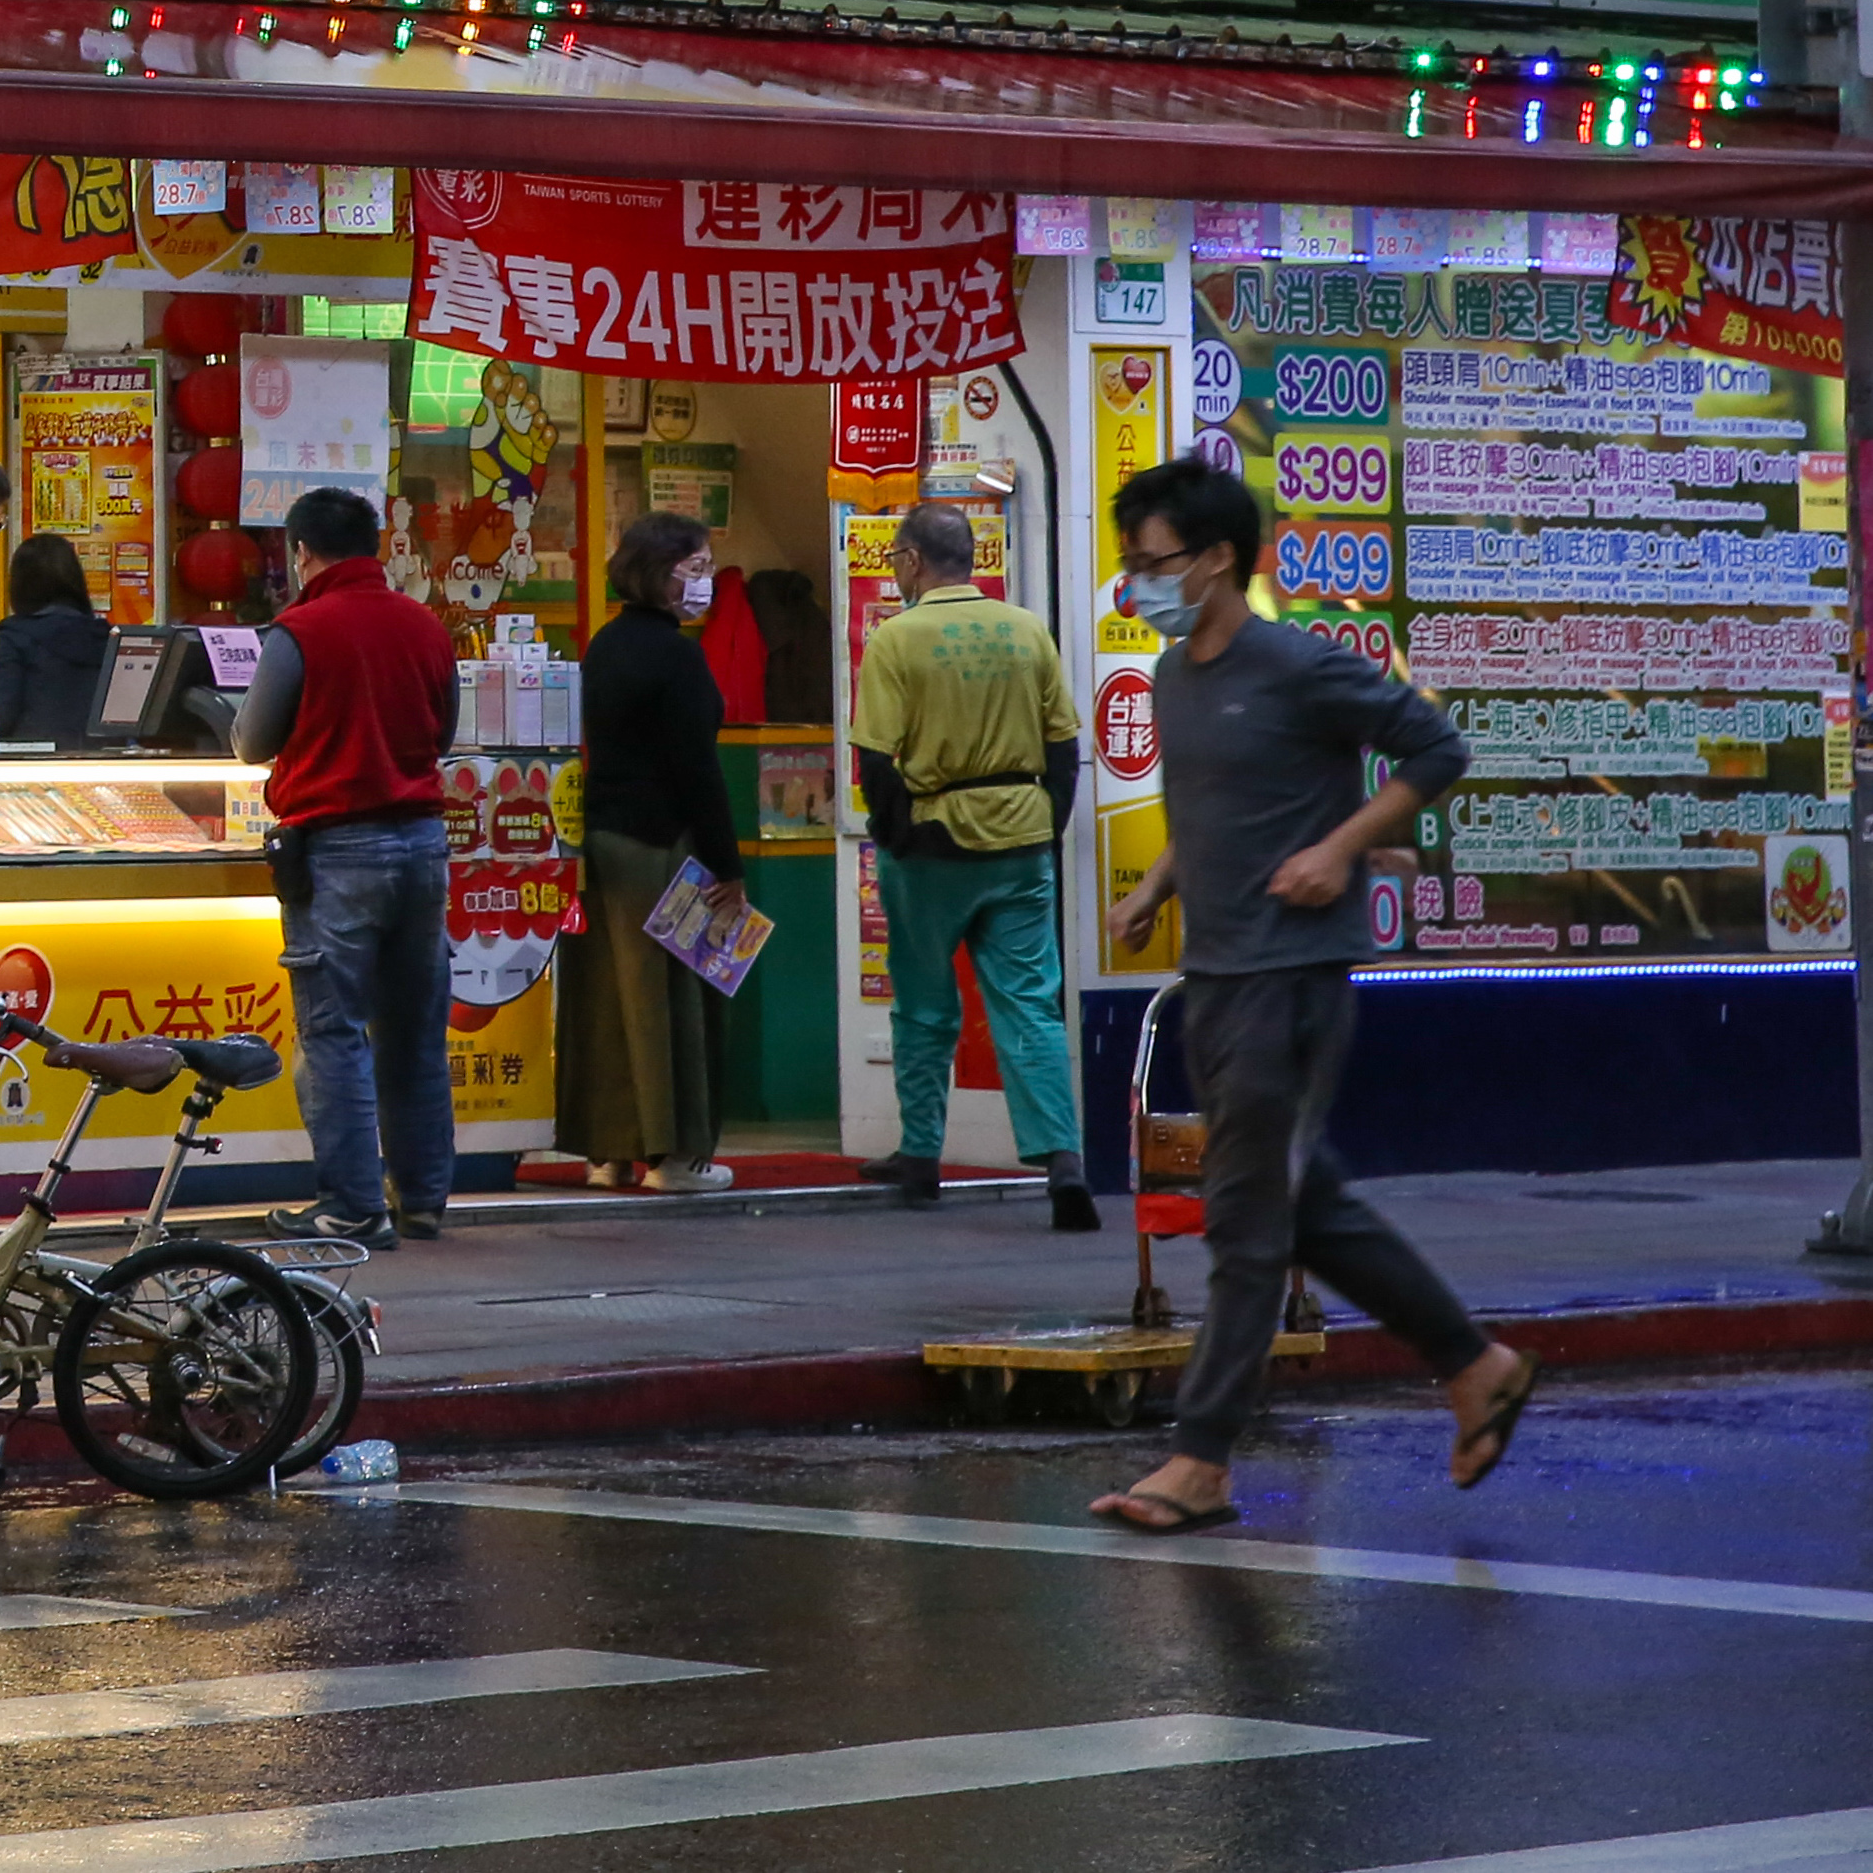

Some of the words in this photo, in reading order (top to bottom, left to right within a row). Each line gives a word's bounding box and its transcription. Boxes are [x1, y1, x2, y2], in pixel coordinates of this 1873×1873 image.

[524, 184, 566, 198] TAIWAN
[569, 187, 611, 205] SPORTS
[615, 192, 664, 209] LOTTERY
[417, 235, 1016, 376] 賽事24H開放投注
[1121, 284, 1159, 315] 147
[1194, 350, 1232, 388] 20
[1277, 354, 1385, 418] $200
[1196, 389, 1230, 413] min
[1403, 390, 1450, 407] Shoulder
[1455, 394, 1500, 411] massage
[1278, 446, 1388, 504] $399
[1277, 530, 1390, 595] $499
